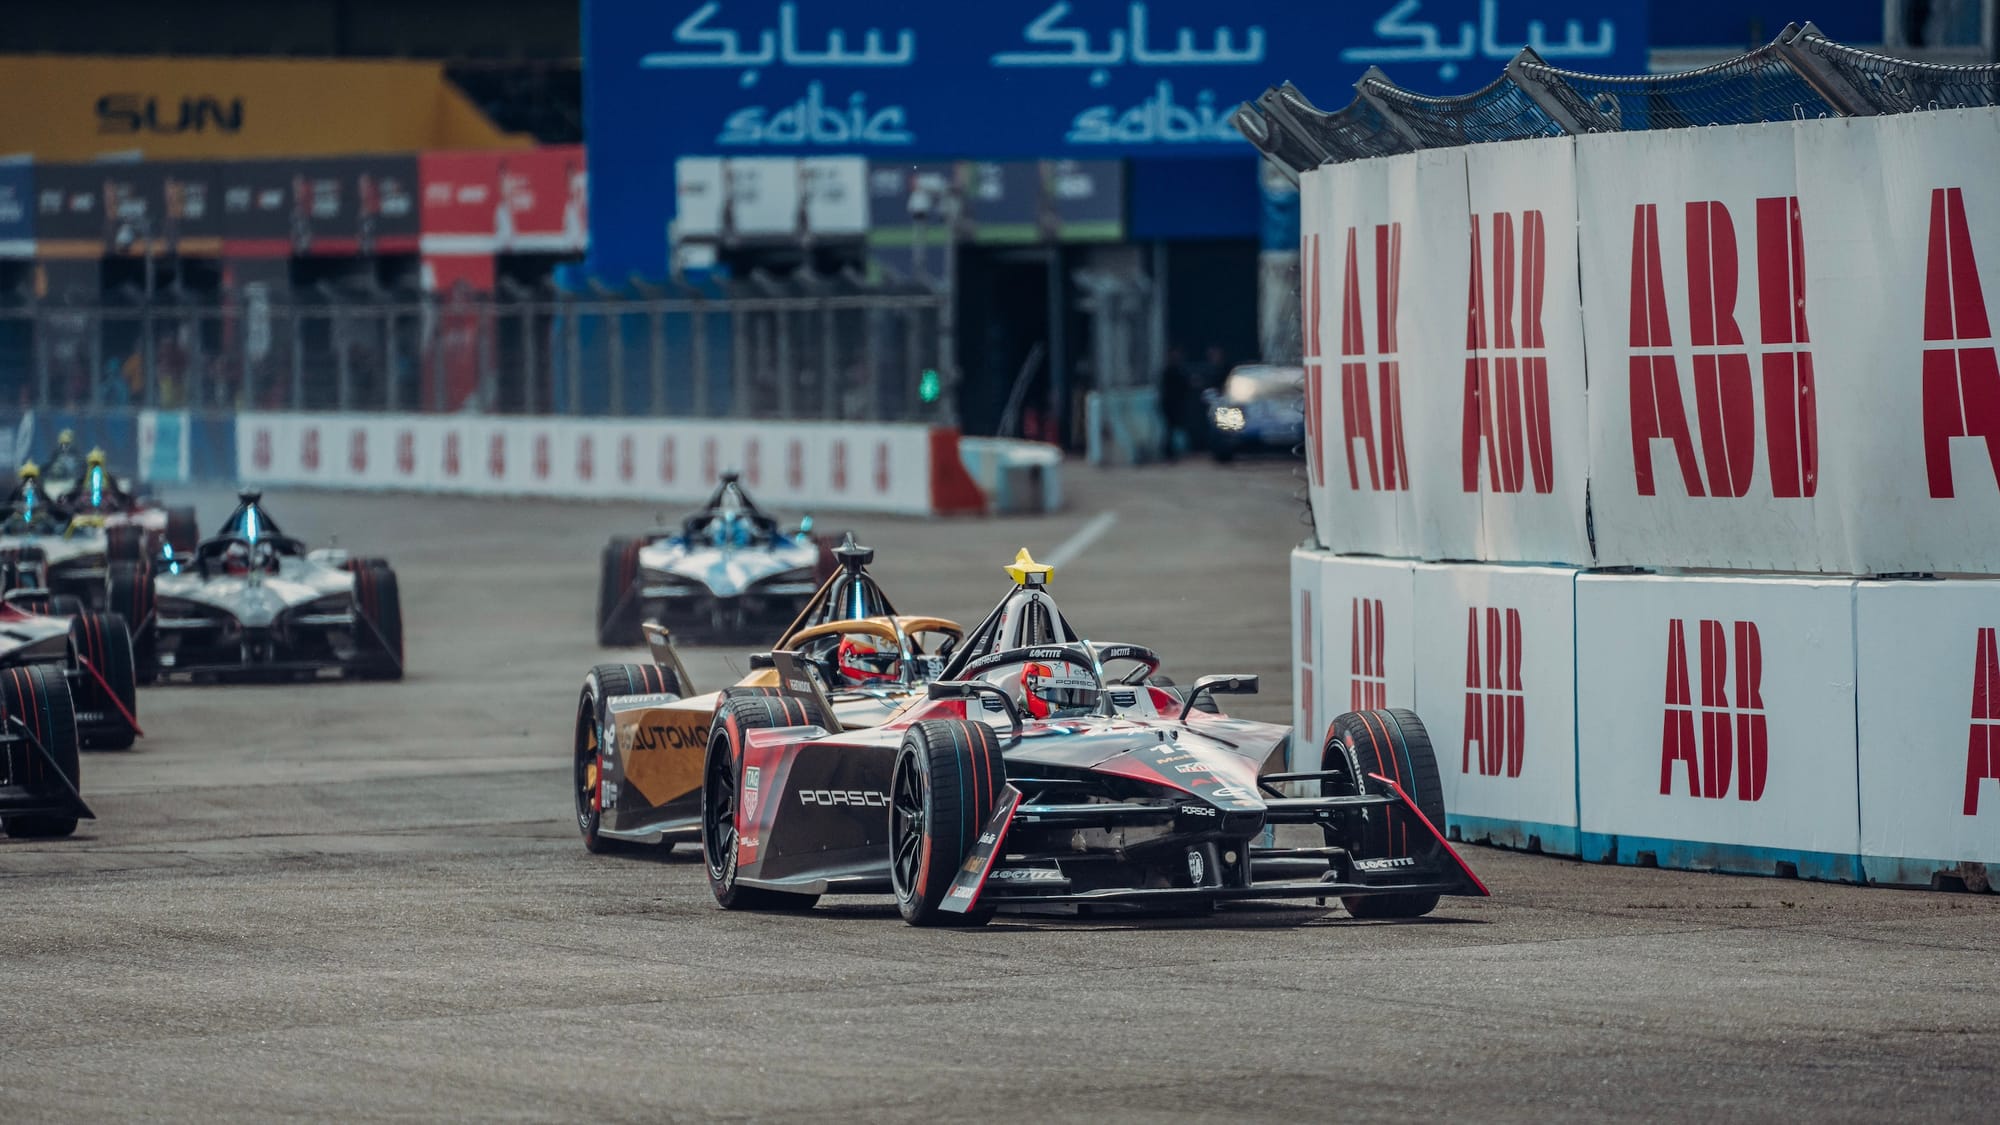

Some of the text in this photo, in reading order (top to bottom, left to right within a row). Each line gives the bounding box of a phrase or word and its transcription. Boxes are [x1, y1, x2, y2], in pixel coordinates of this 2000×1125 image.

[95, 94, 244, 134] SUN
[715, 81, 916, 145] sabic
[1462, 209, 1554, 495] ABB
[1629, 197, 1818, 499] ABB
[1029, 649, 1062, 658] LOCTITE
[1110, 648, 1131, 657] LOCTITE
[1056, 679, 1097, 687] PORSC
[1462, 607, 1524, 778] ABB
[1660, 619, 1769, 802] ABB
[632, 726, 711, 751] AUTOMO
[746, 771, 759, 789] TAG
[1349, 745, 1369, 822] Hankok
[798, 790, 892, 807] PORSCH
[1182, 806, 1216, 816] PORSCHE
[1359, 857, 1415, 870] LOCTITE
[989, 870, 1060, 880] LOCTITE
